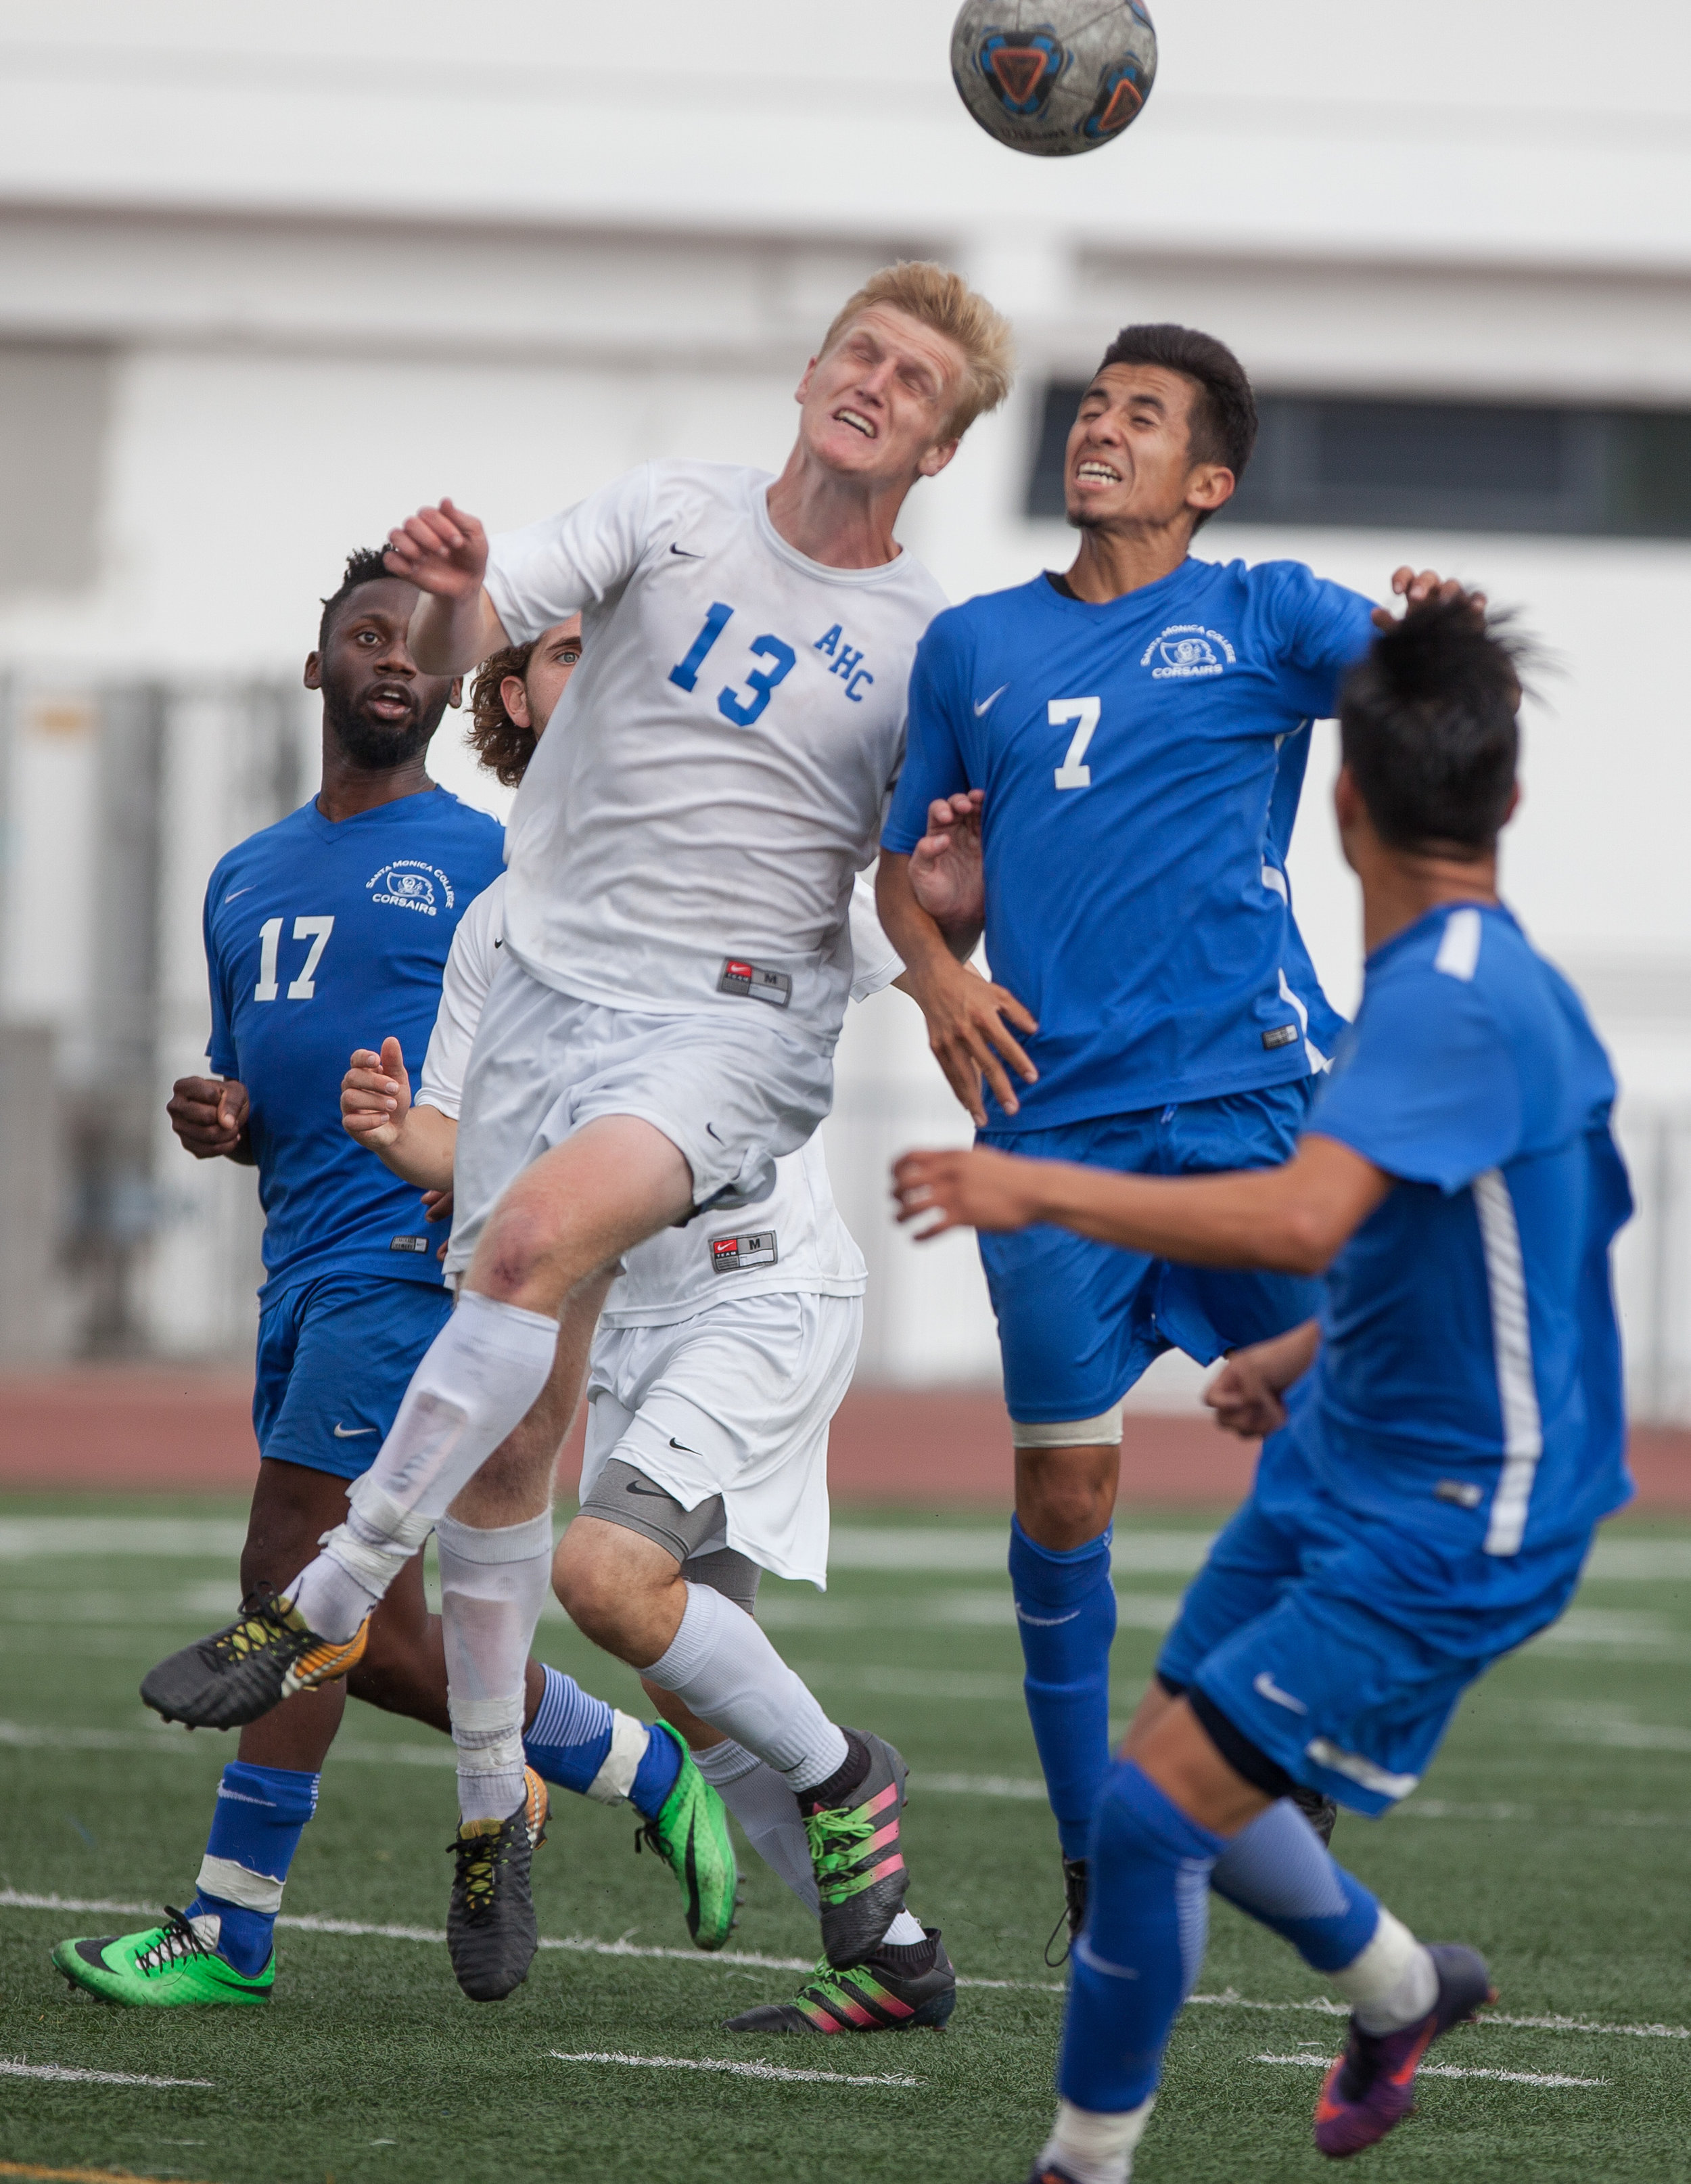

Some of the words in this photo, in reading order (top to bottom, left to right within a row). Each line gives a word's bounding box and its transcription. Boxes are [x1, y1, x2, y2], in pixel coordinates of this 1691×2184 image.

[1161, 624, 1205, 638] MONICA
[668, 601, 796, 727] 13
[814, 623, 873, 702] AHC
[1152, 664, 1223, 679] CORSAIRS
[1048, 696, 1101, 790] 7
[366, 865, 392, 888] SANTA
[393, 860, 433, 872] MONICA
[434, 869, 455, 909] COLLEGE
[372, 893, 437, 916] CORSAIRS
[254, 915, 335, 1001] 17
[764, 974, 777, 984] M
[749, 1238, 760, 1250] M
